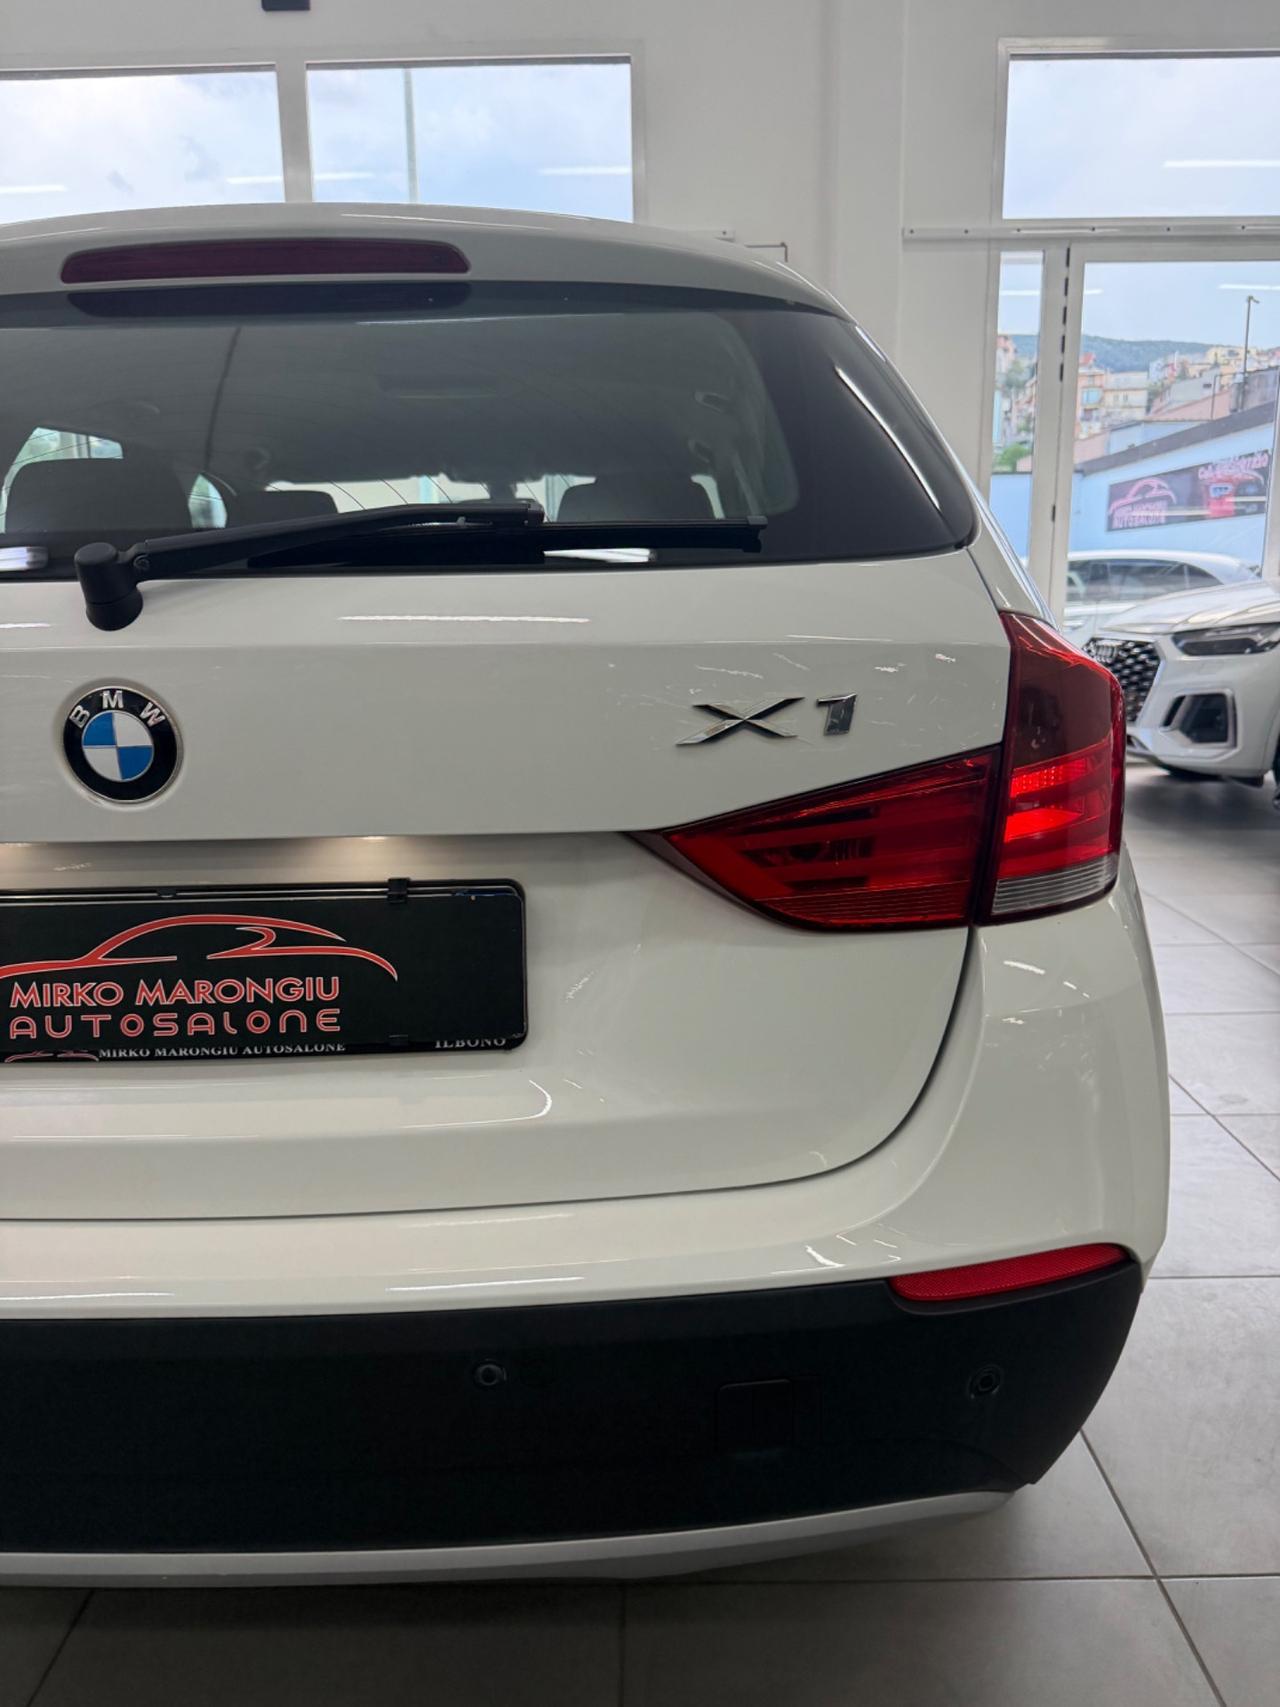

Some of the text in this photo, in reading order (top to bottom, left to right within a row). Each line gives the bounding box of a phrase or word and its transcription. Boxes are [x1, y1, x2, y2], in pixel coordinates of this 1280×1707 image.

[69, 690, 165, 728] BMW
[675, 692, 857, 746] X1
[9, 976, 340, 1008] MIRKO MARONGIU
[9, 1008, 341, 1039] AUTOSALONE
[99, 1043, 346, 1058] MIRKO MARONGIU AUTOSALONE
[435, 1038, 506, 1049] ILBONO
